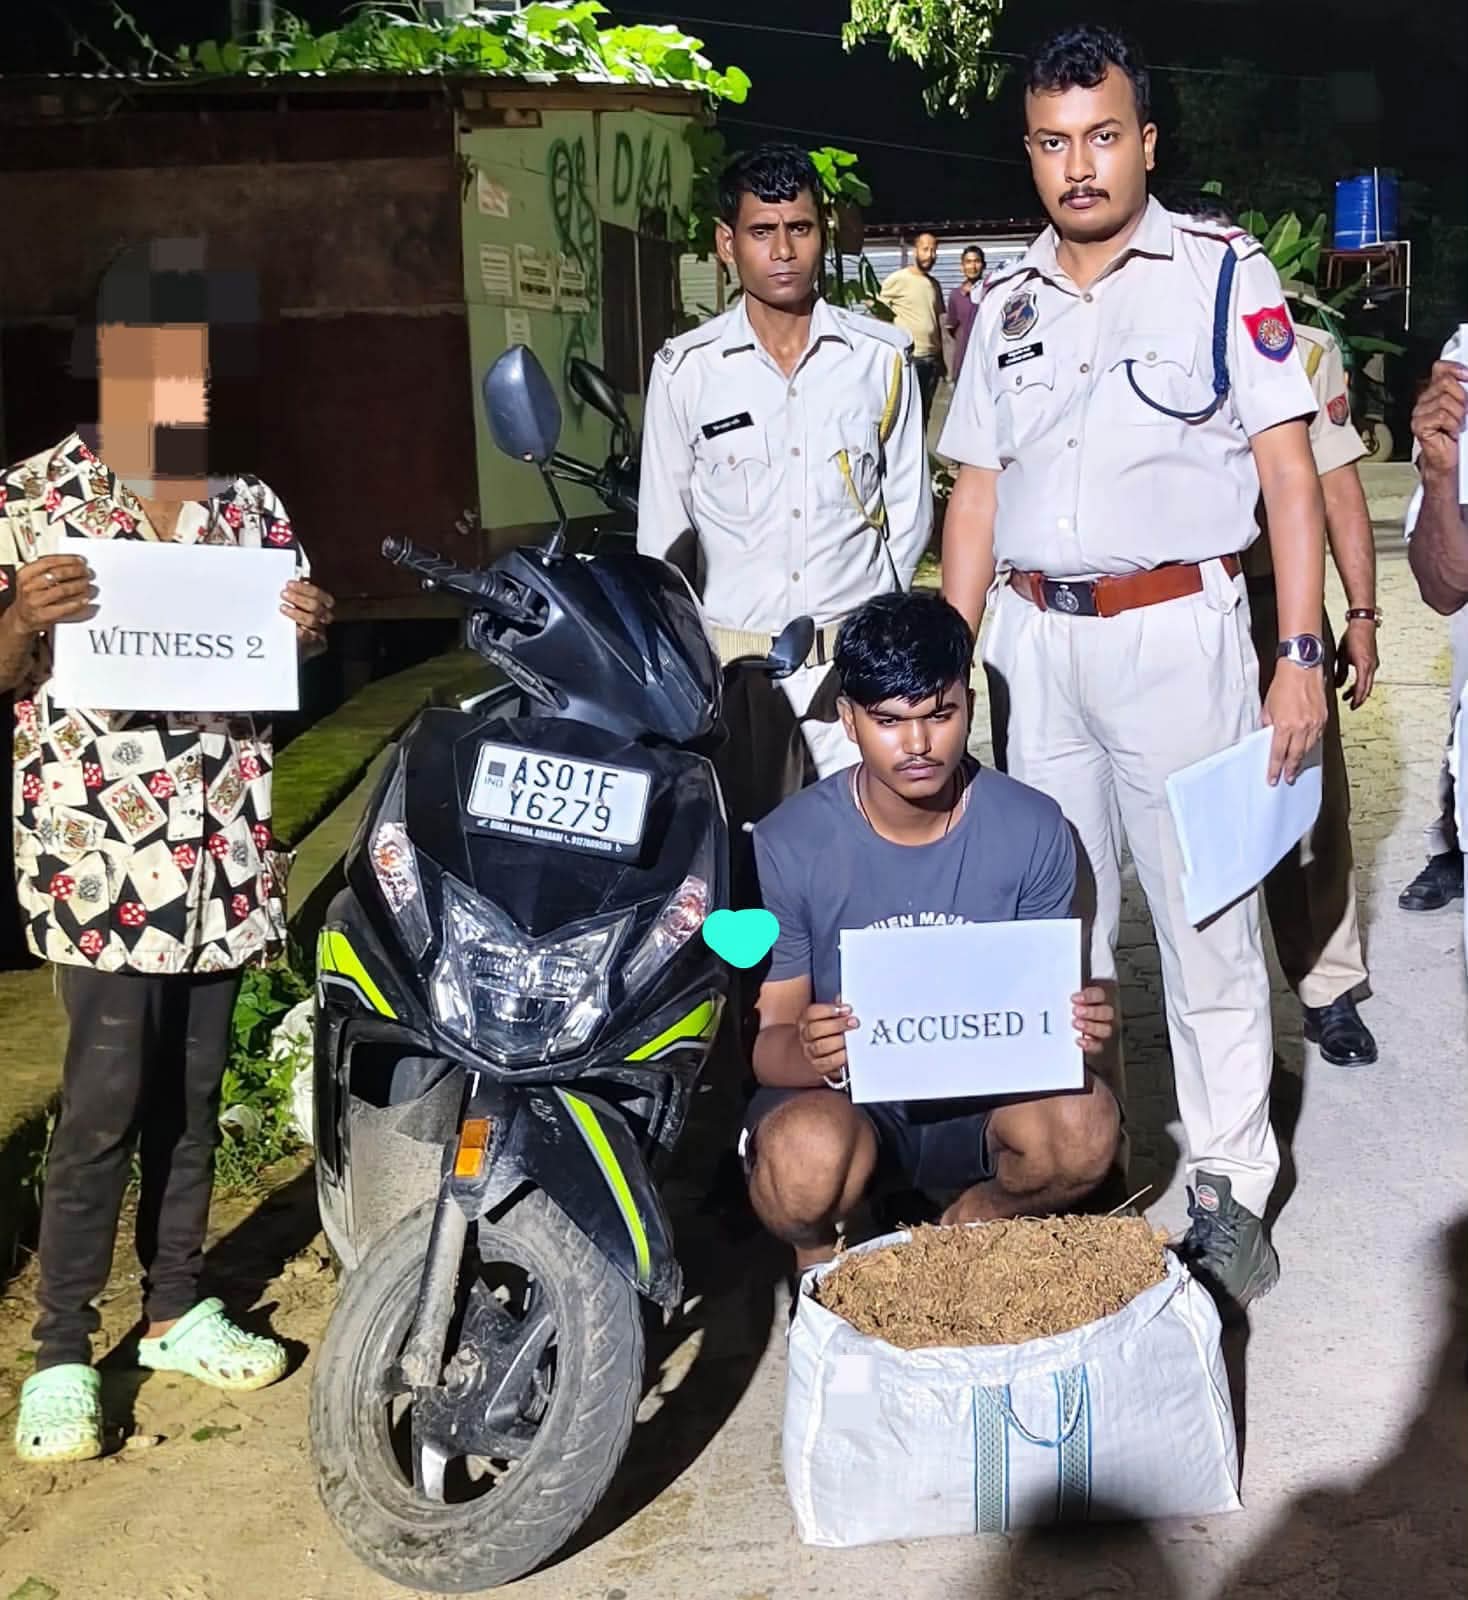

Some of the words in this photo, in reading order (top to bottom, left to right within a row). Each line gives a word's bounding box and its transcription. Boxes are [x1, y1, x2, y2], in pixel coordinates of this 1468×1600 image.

[88, 626, 234, 659] WITNESS
[246, 635, 265, 659] 2
[510, 789, 612, 833] Y6279
[869, 1011, 1025, 1046] ACCUSED
[1038, 1010, 1053, 1036] 1
